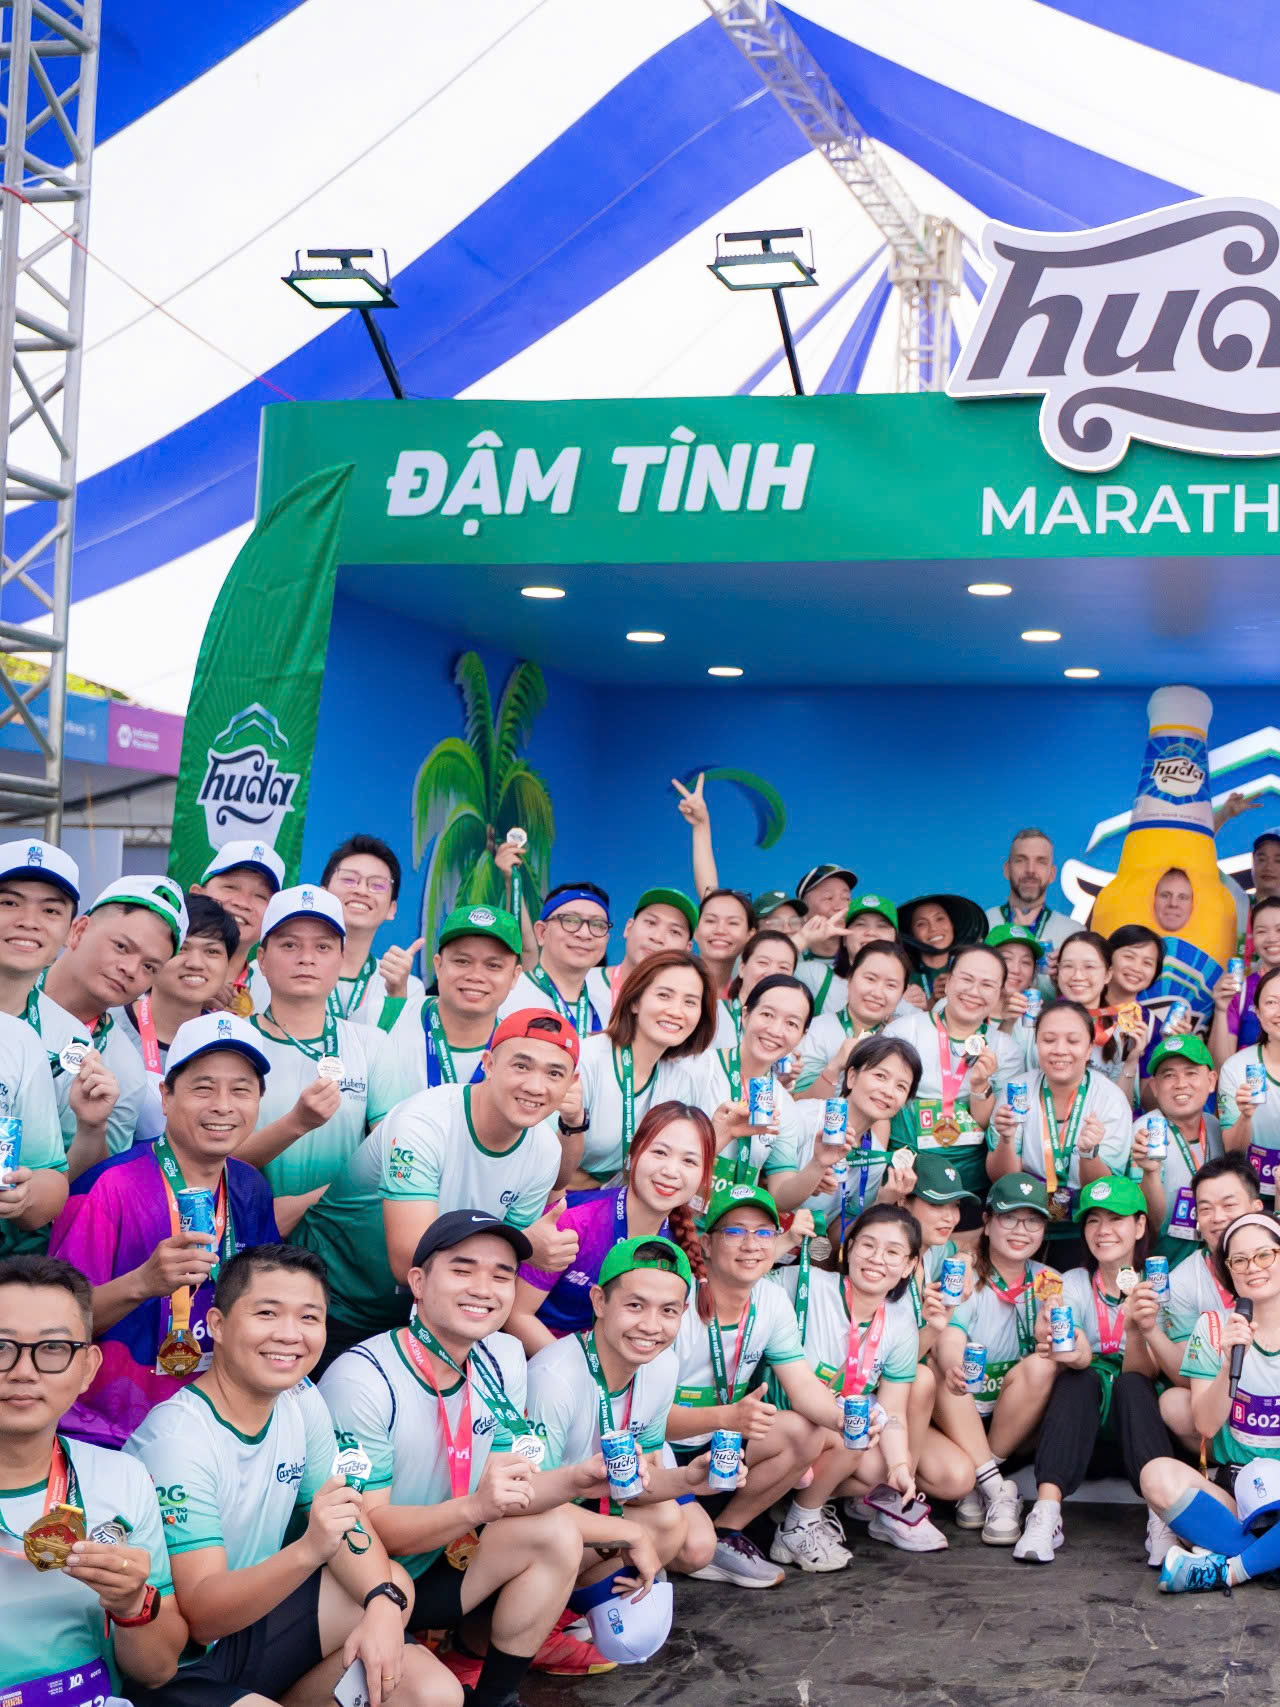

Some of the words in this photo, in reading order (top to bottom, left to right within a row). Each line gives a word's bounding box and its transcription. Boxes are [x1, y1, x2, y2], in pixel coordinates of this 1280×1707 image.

[387, 430, 582, 535] ĐẬM
[611, 424, 816, 515] TÌNH
[1153, 757, 1204, 784] huda
[202, 749, 295, 825] huda
[277, 1457, 306, 1483] Carlsb
[608, 1454, 636, 1476] huda
[713, 1448, 740, 1466] huda
